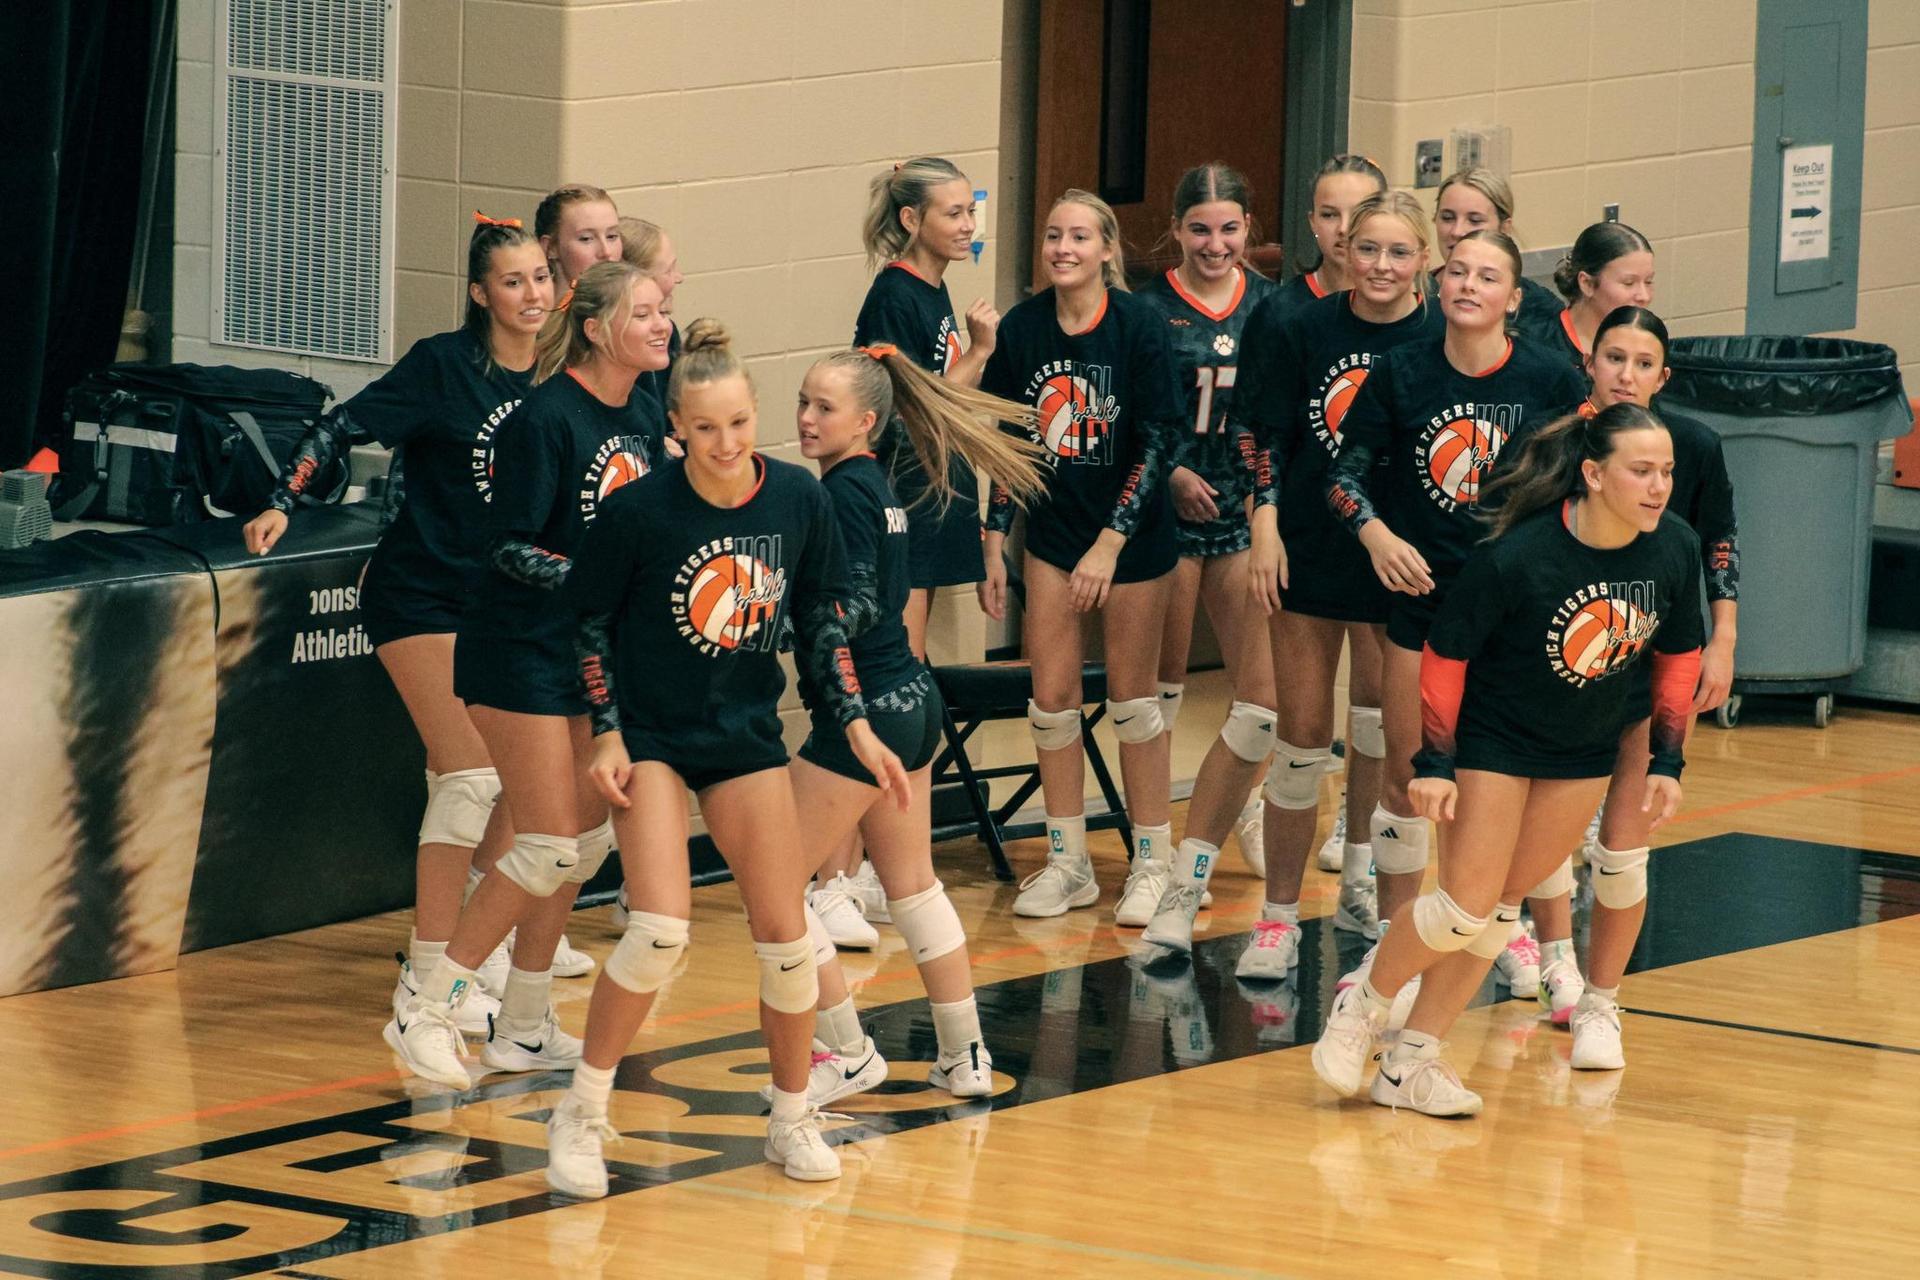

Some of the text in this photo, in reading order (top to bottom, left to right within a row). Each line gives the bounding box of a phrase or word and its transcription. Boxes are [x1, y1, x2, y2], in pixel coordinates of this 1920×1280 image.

[1025, 360, 1072, 397] TIGERS
[1415, 403, 1475, 512] IPSWICH TIGERS
[671, 536, 734, 658] IPSWICH TIGERS
[1546, 582, 1609, 688] IPSWICH TIGERS
